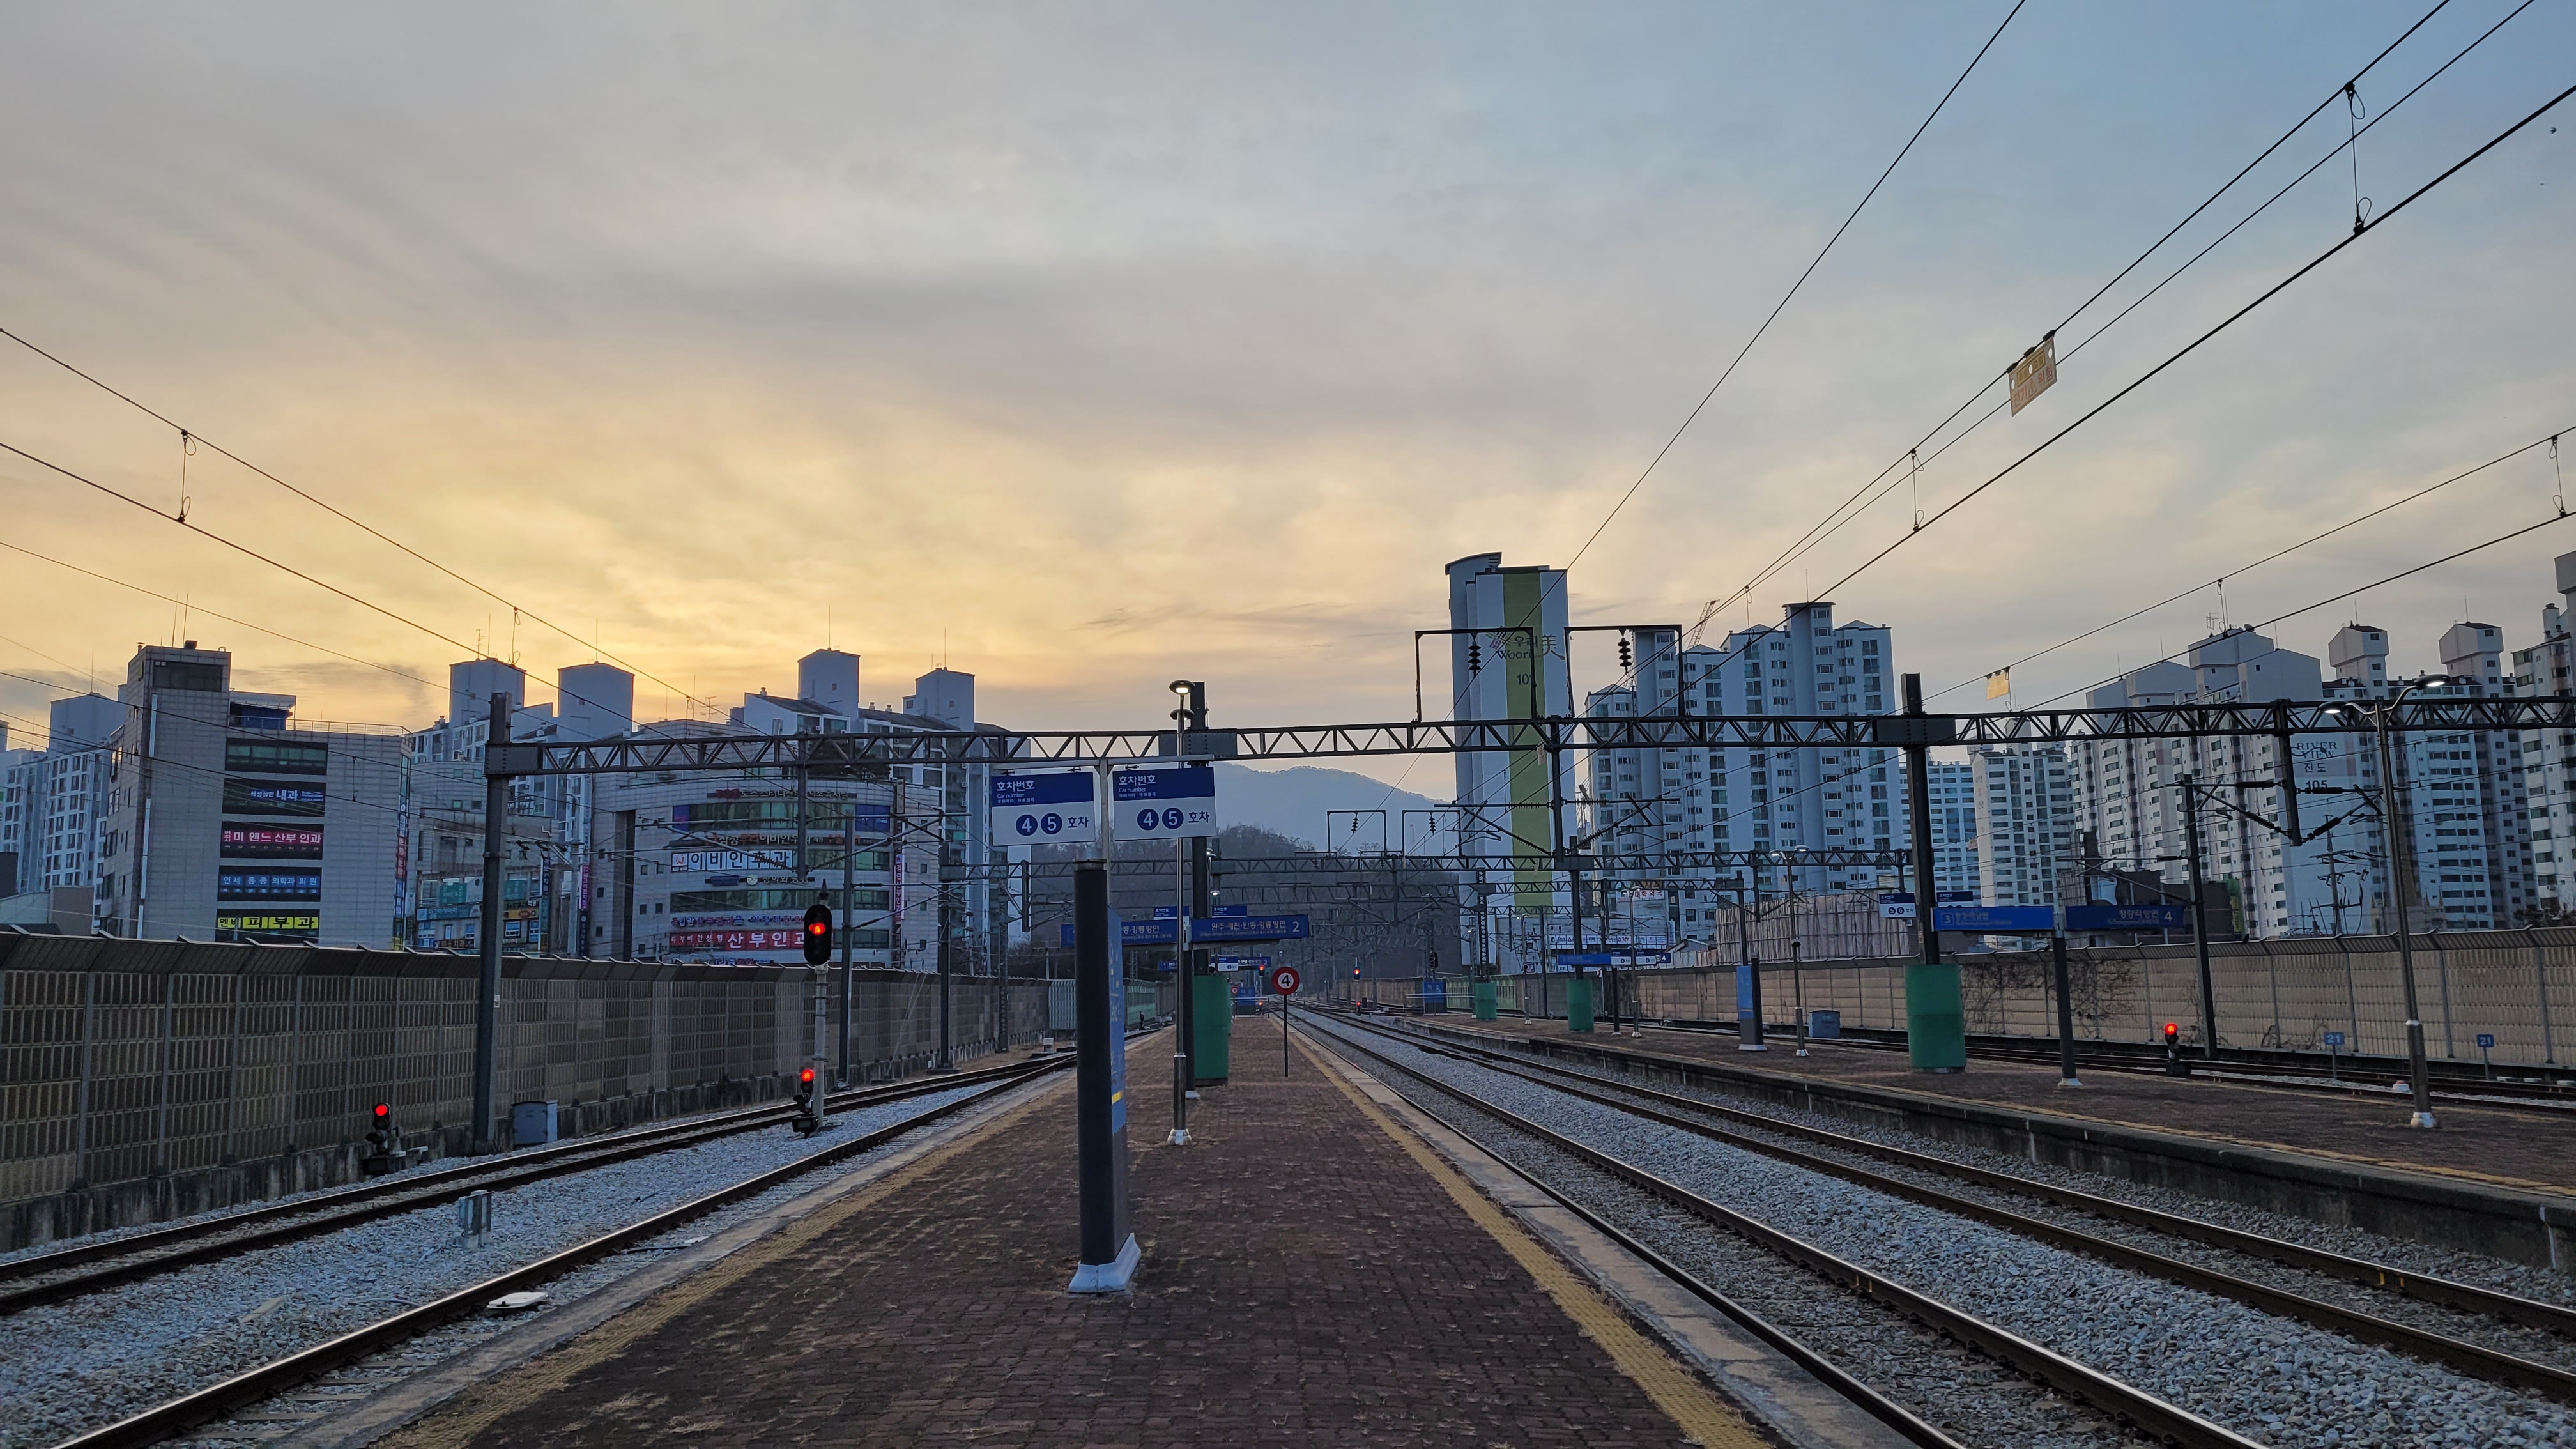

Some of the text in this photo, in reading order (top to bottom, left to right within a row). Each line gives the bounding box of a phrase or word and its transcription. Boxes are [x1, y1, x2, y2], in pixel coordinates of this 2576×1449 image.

[2037, 363, 2053, 388] 위험
[2304, 763, 2326, 773] 진도
[996, 779, 1036, 792] 호차번호
[1118, 774, 1157, 786] 호차번호
[275, 789, 299, 801] 내과
[1021, 816, 1089, 832] 4 5 호차
[1142, 811, 1210, 827] 4 5 호차
[1944, 915, 1951, 924] 3
[2164, 911, 2173, 922] 4
[247, 917, 315, 928] 피부과
[1292, 921, 1301, 932] 2
[1280, 974, 1291, 986] 4
[2326, 1034, 2341, 1043] 21
[2479, 1038, 2492, 1046] 21
